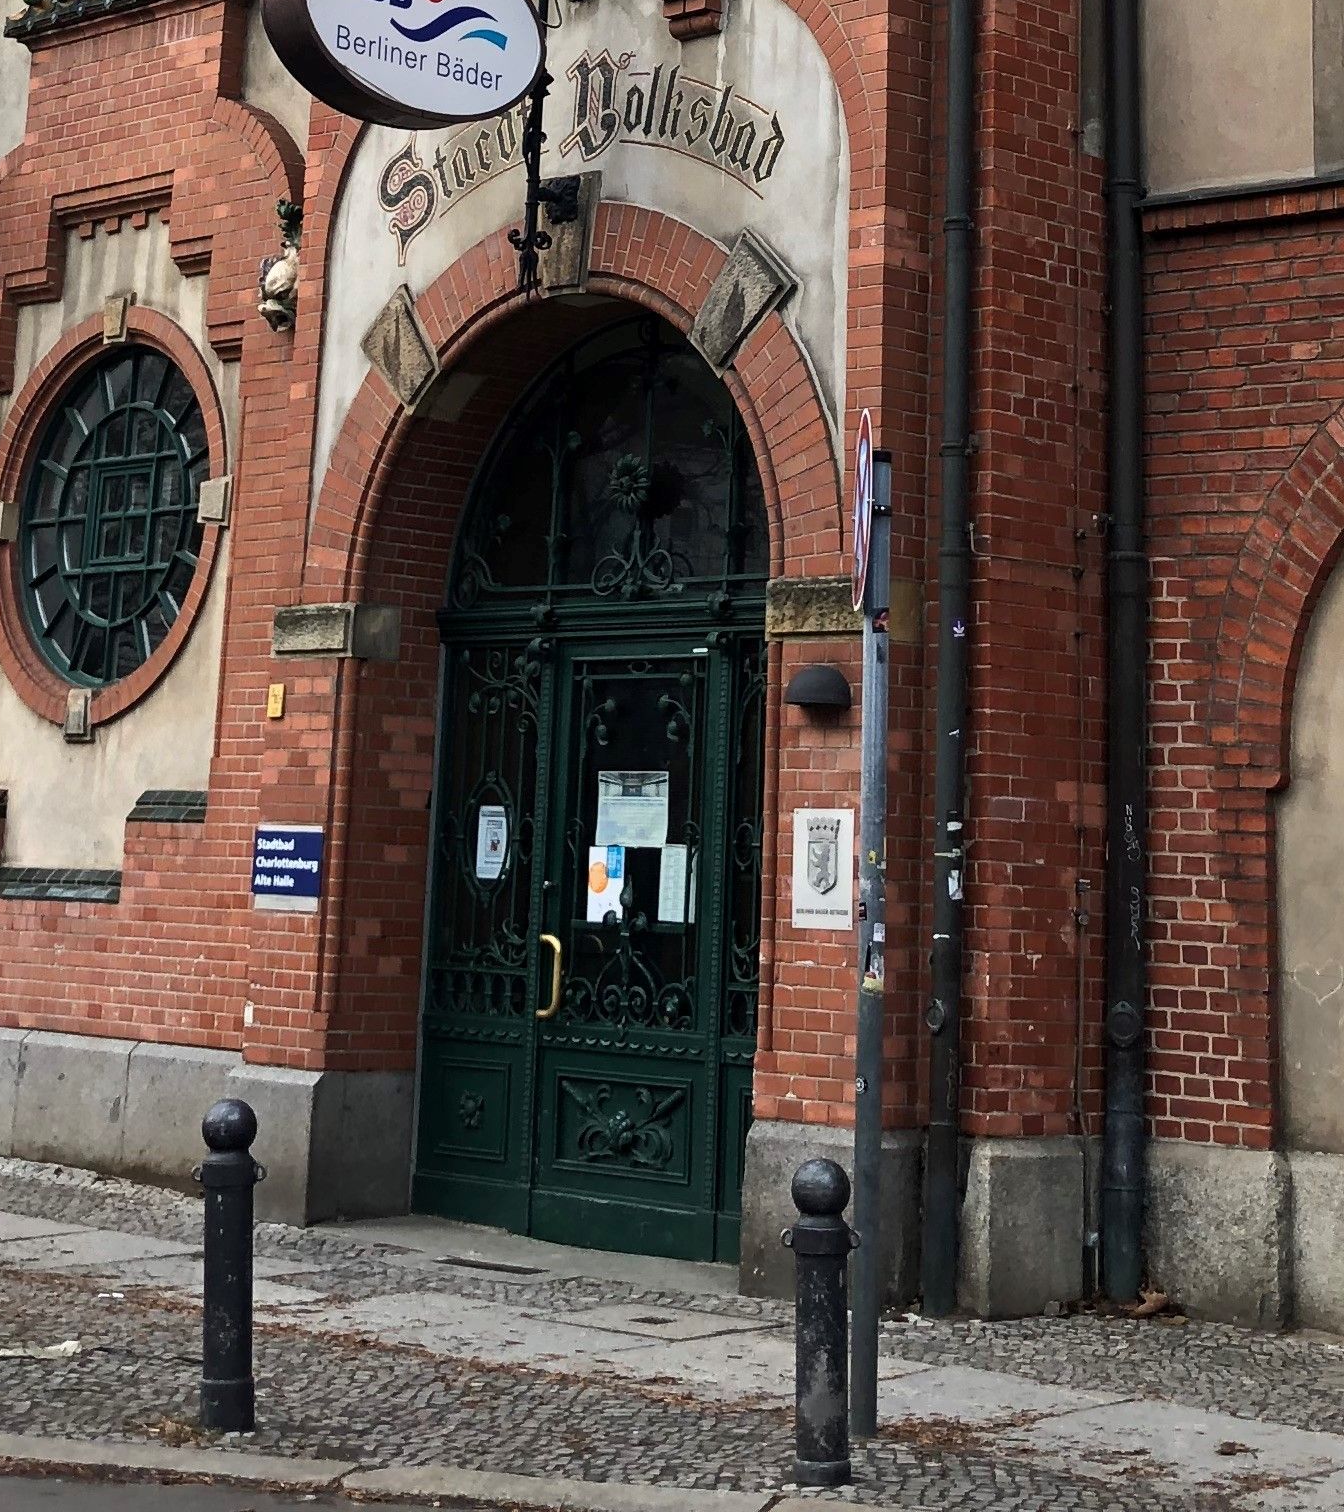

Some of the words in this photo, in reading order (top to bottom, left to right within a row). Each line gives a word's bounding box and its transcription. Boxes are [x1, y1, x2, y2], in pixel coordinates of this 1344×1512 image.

[336, 24, 428, 71] Berliner
[436, 52, 503, 91] Bäder
[560, 48, 786, 185] Volksbad
[257, 838, 294, 850] Stadtbad
[256, 856, 318, 873] Charlottenburg
[254, 874, 272, 886] Alte
[273, 874, 294, 887] Halle
